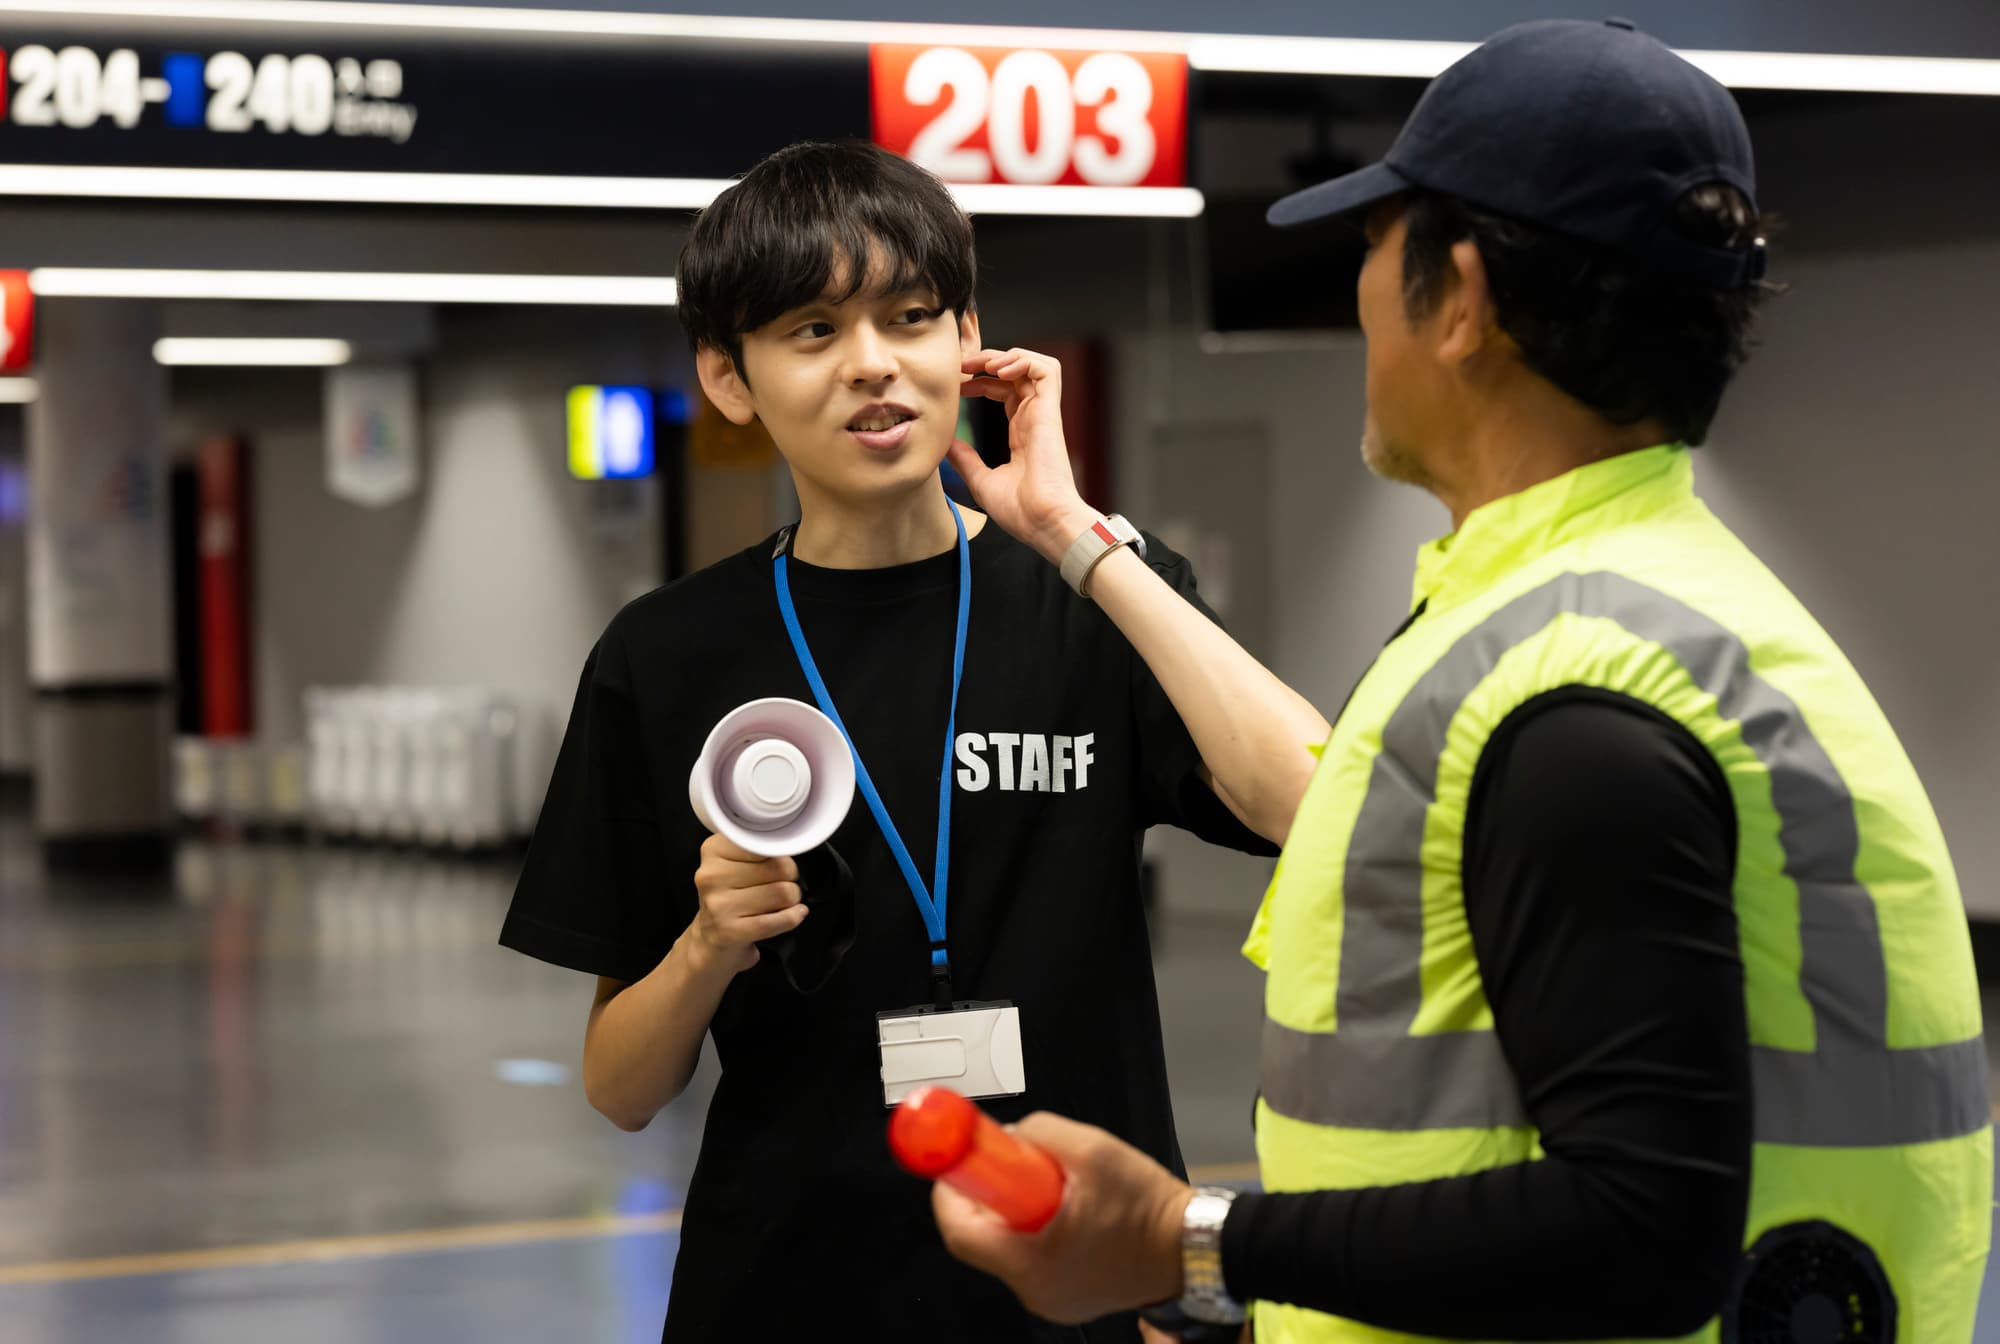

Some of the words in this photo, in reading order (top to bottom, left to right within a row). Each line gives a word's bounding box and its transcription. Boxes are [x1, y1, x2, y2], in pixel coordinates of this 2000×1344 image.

[204, 51, 334, 135] 240
[904, 47, 1156, 186] 203
[955, 732, 1094, 792] STAFF
